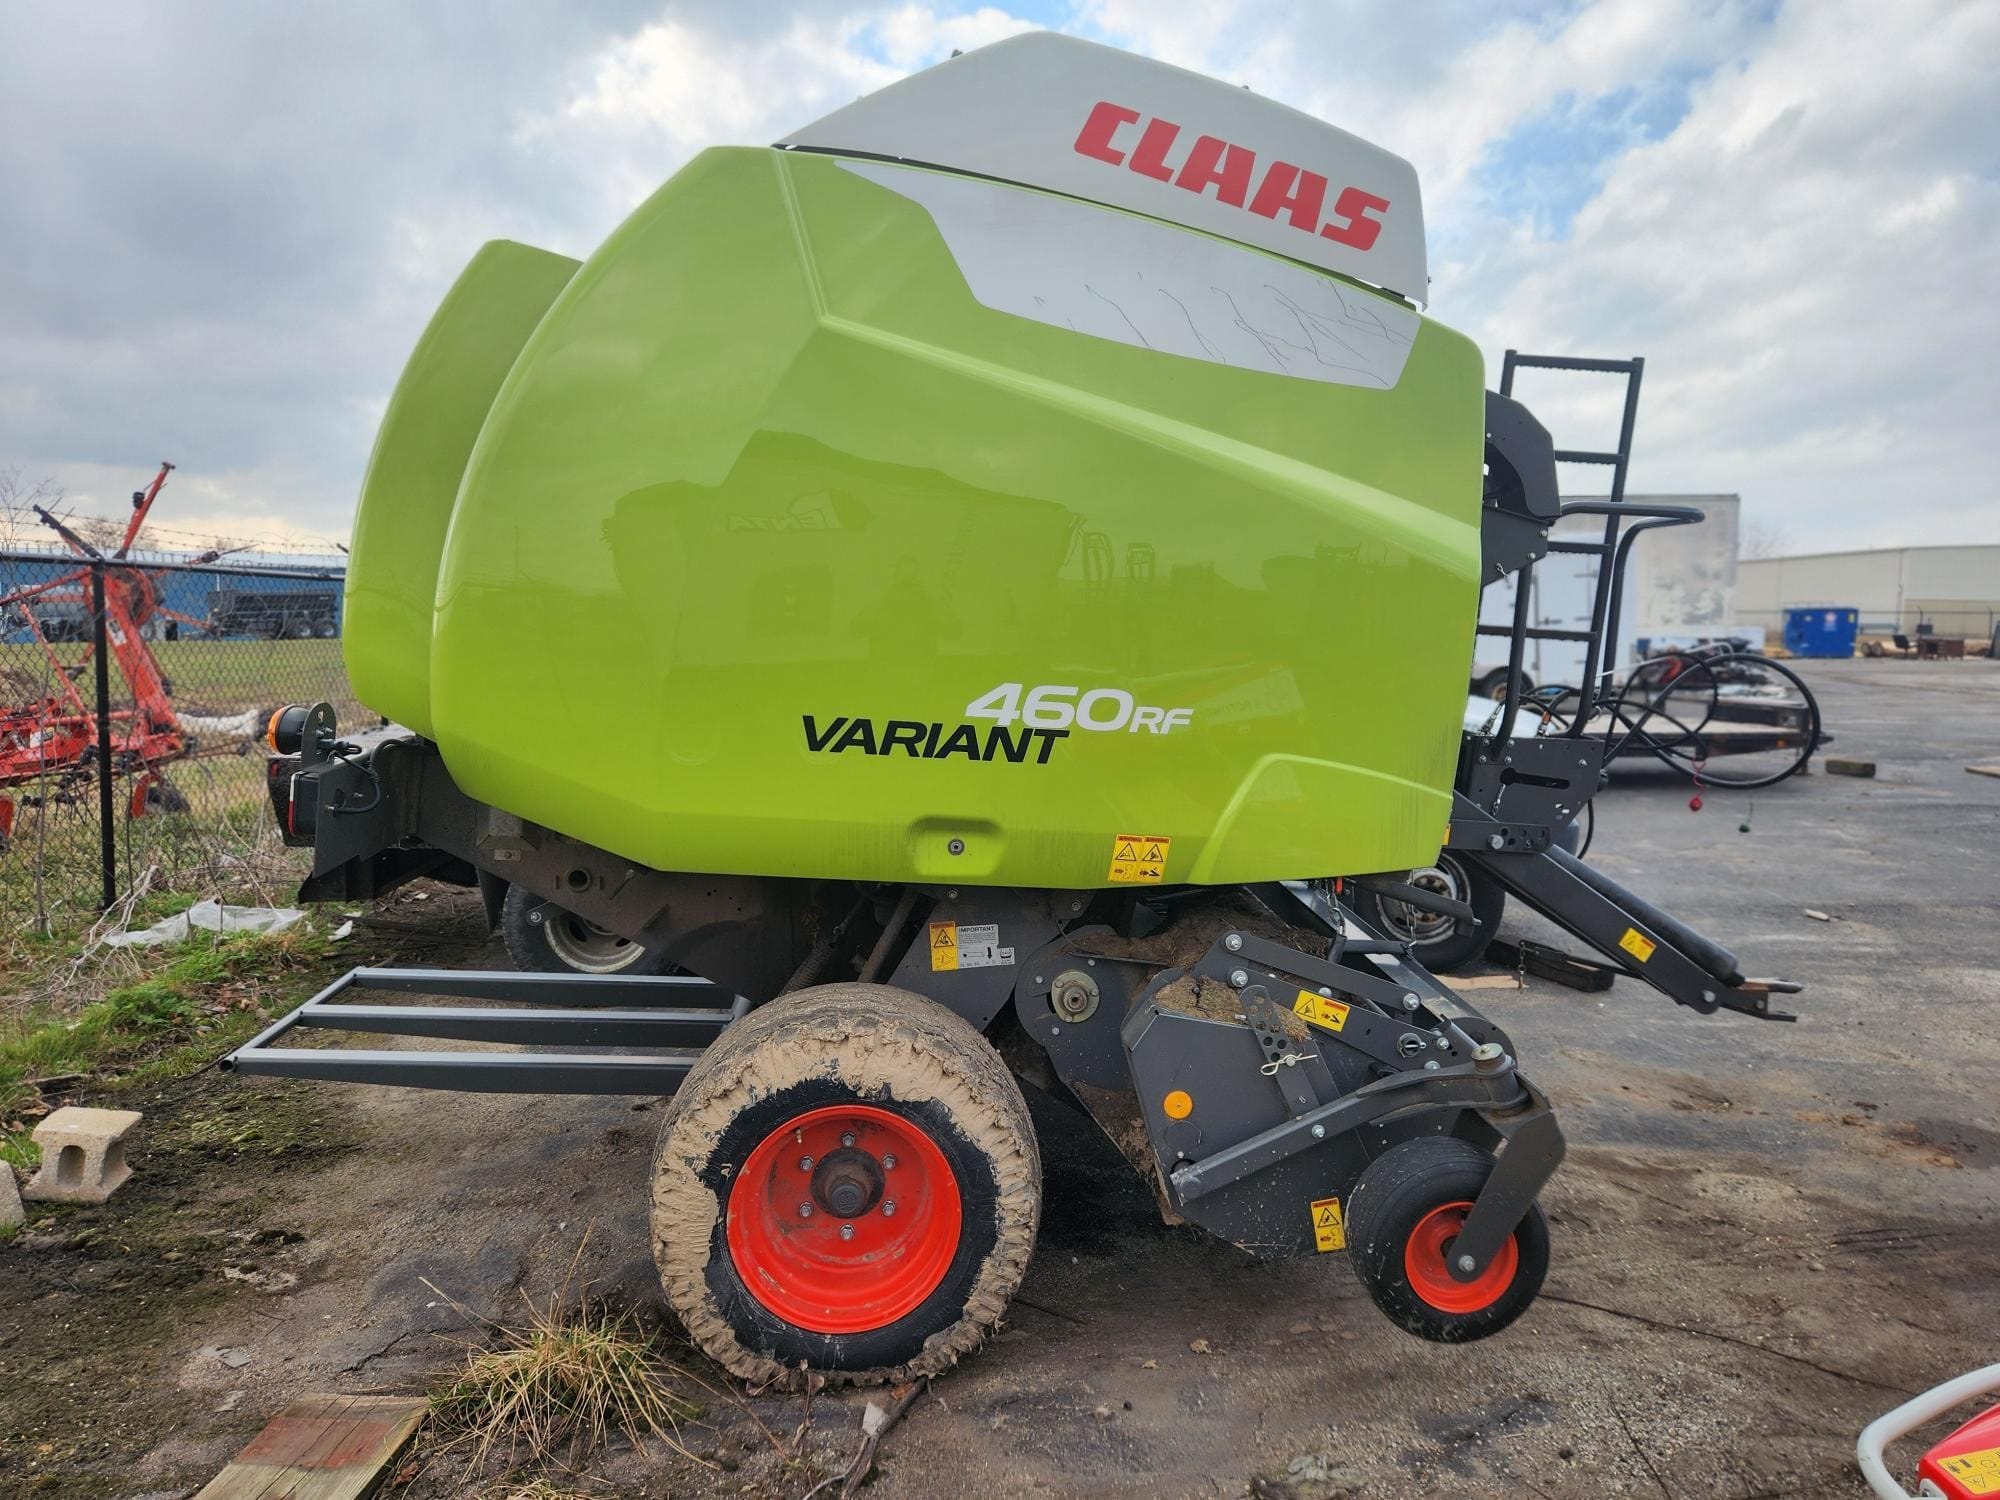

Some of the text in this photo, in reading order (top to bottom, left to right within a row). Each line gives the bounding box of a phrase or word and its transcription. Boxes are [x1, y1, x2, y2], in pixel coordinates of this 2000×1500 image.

[1073, 100, 1391, 252] CLAAS
[802, 714, 1070, 764] VARIANT
[958, 925, 995, 933] IMPORTANT
